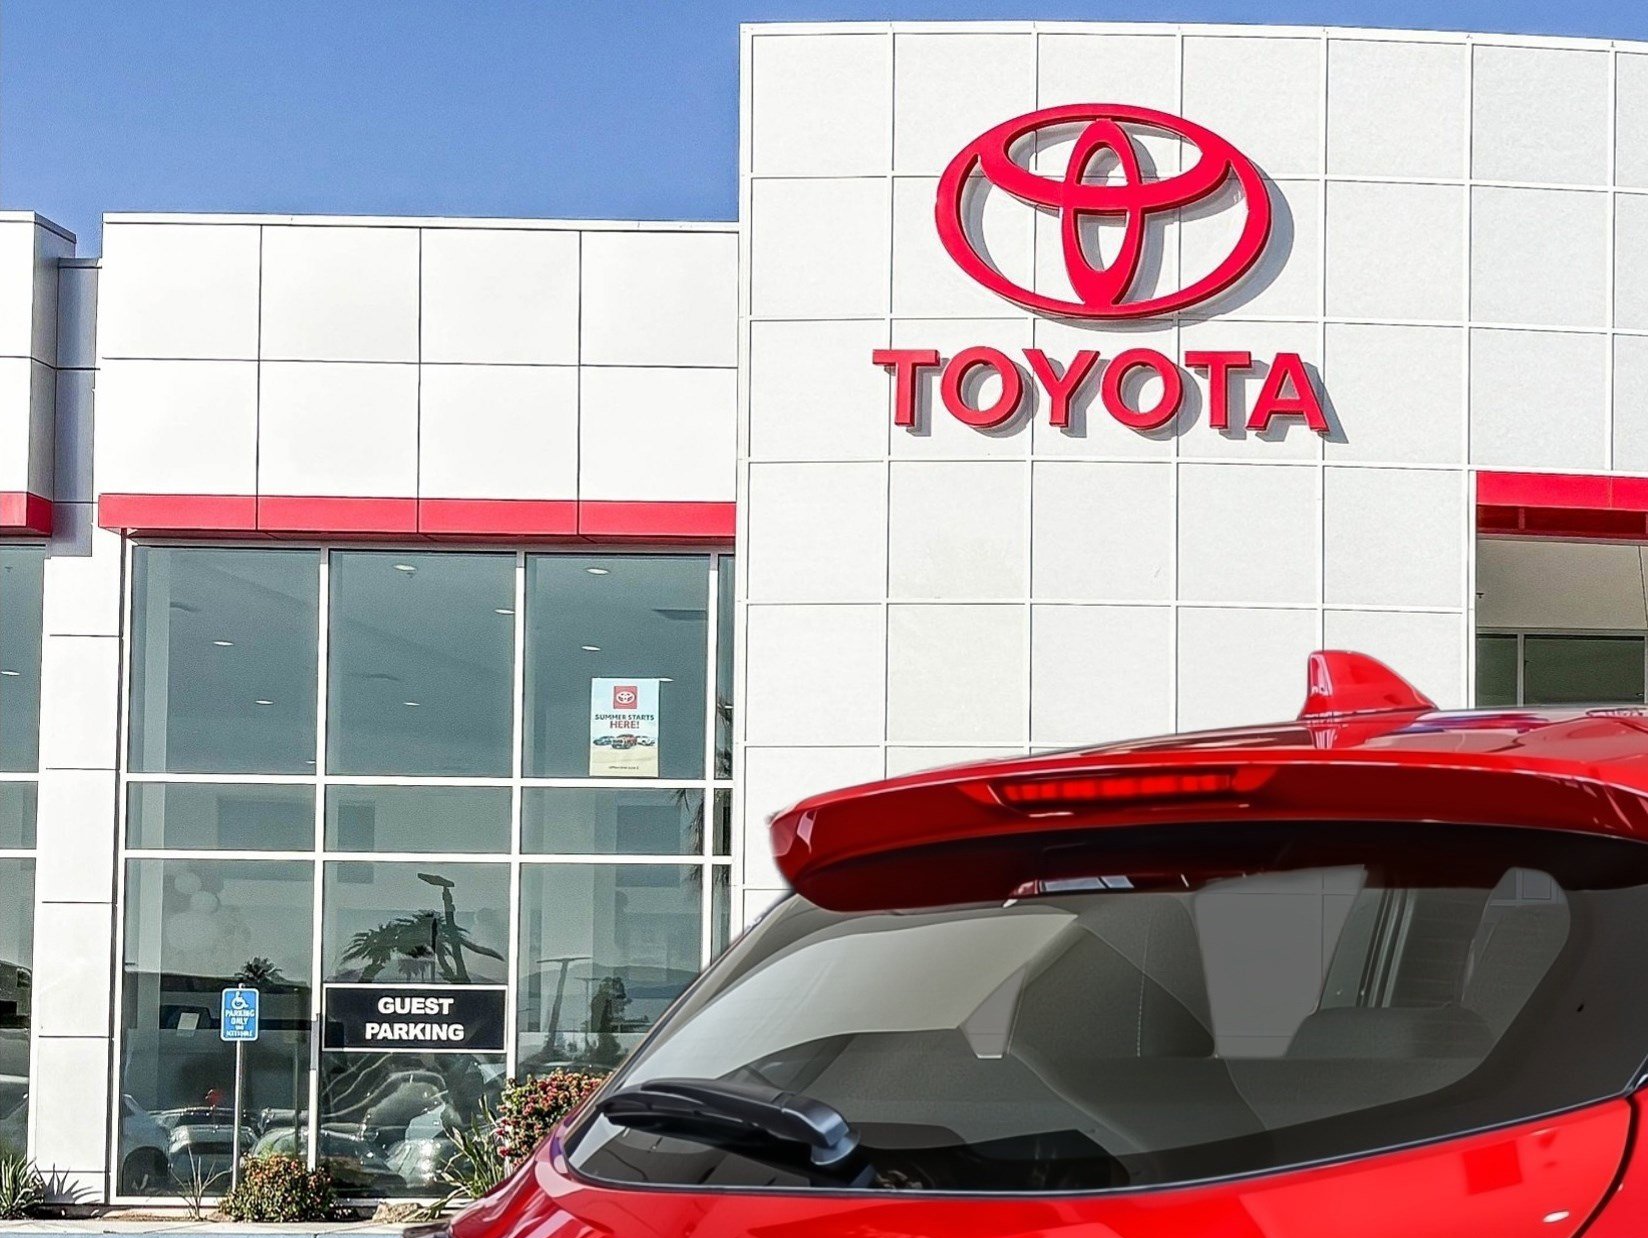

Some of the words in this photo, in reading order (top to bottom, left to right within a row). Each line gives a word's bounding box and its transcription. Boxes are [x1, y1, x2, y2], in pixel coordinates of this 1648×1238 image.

[872, 346, 1330, 434] TOYOTA
[609, 720, 640, 729] HERE!
[377, 997, 454, 1015] GUEST
[364, 1022, 465, 1041] PARKING
